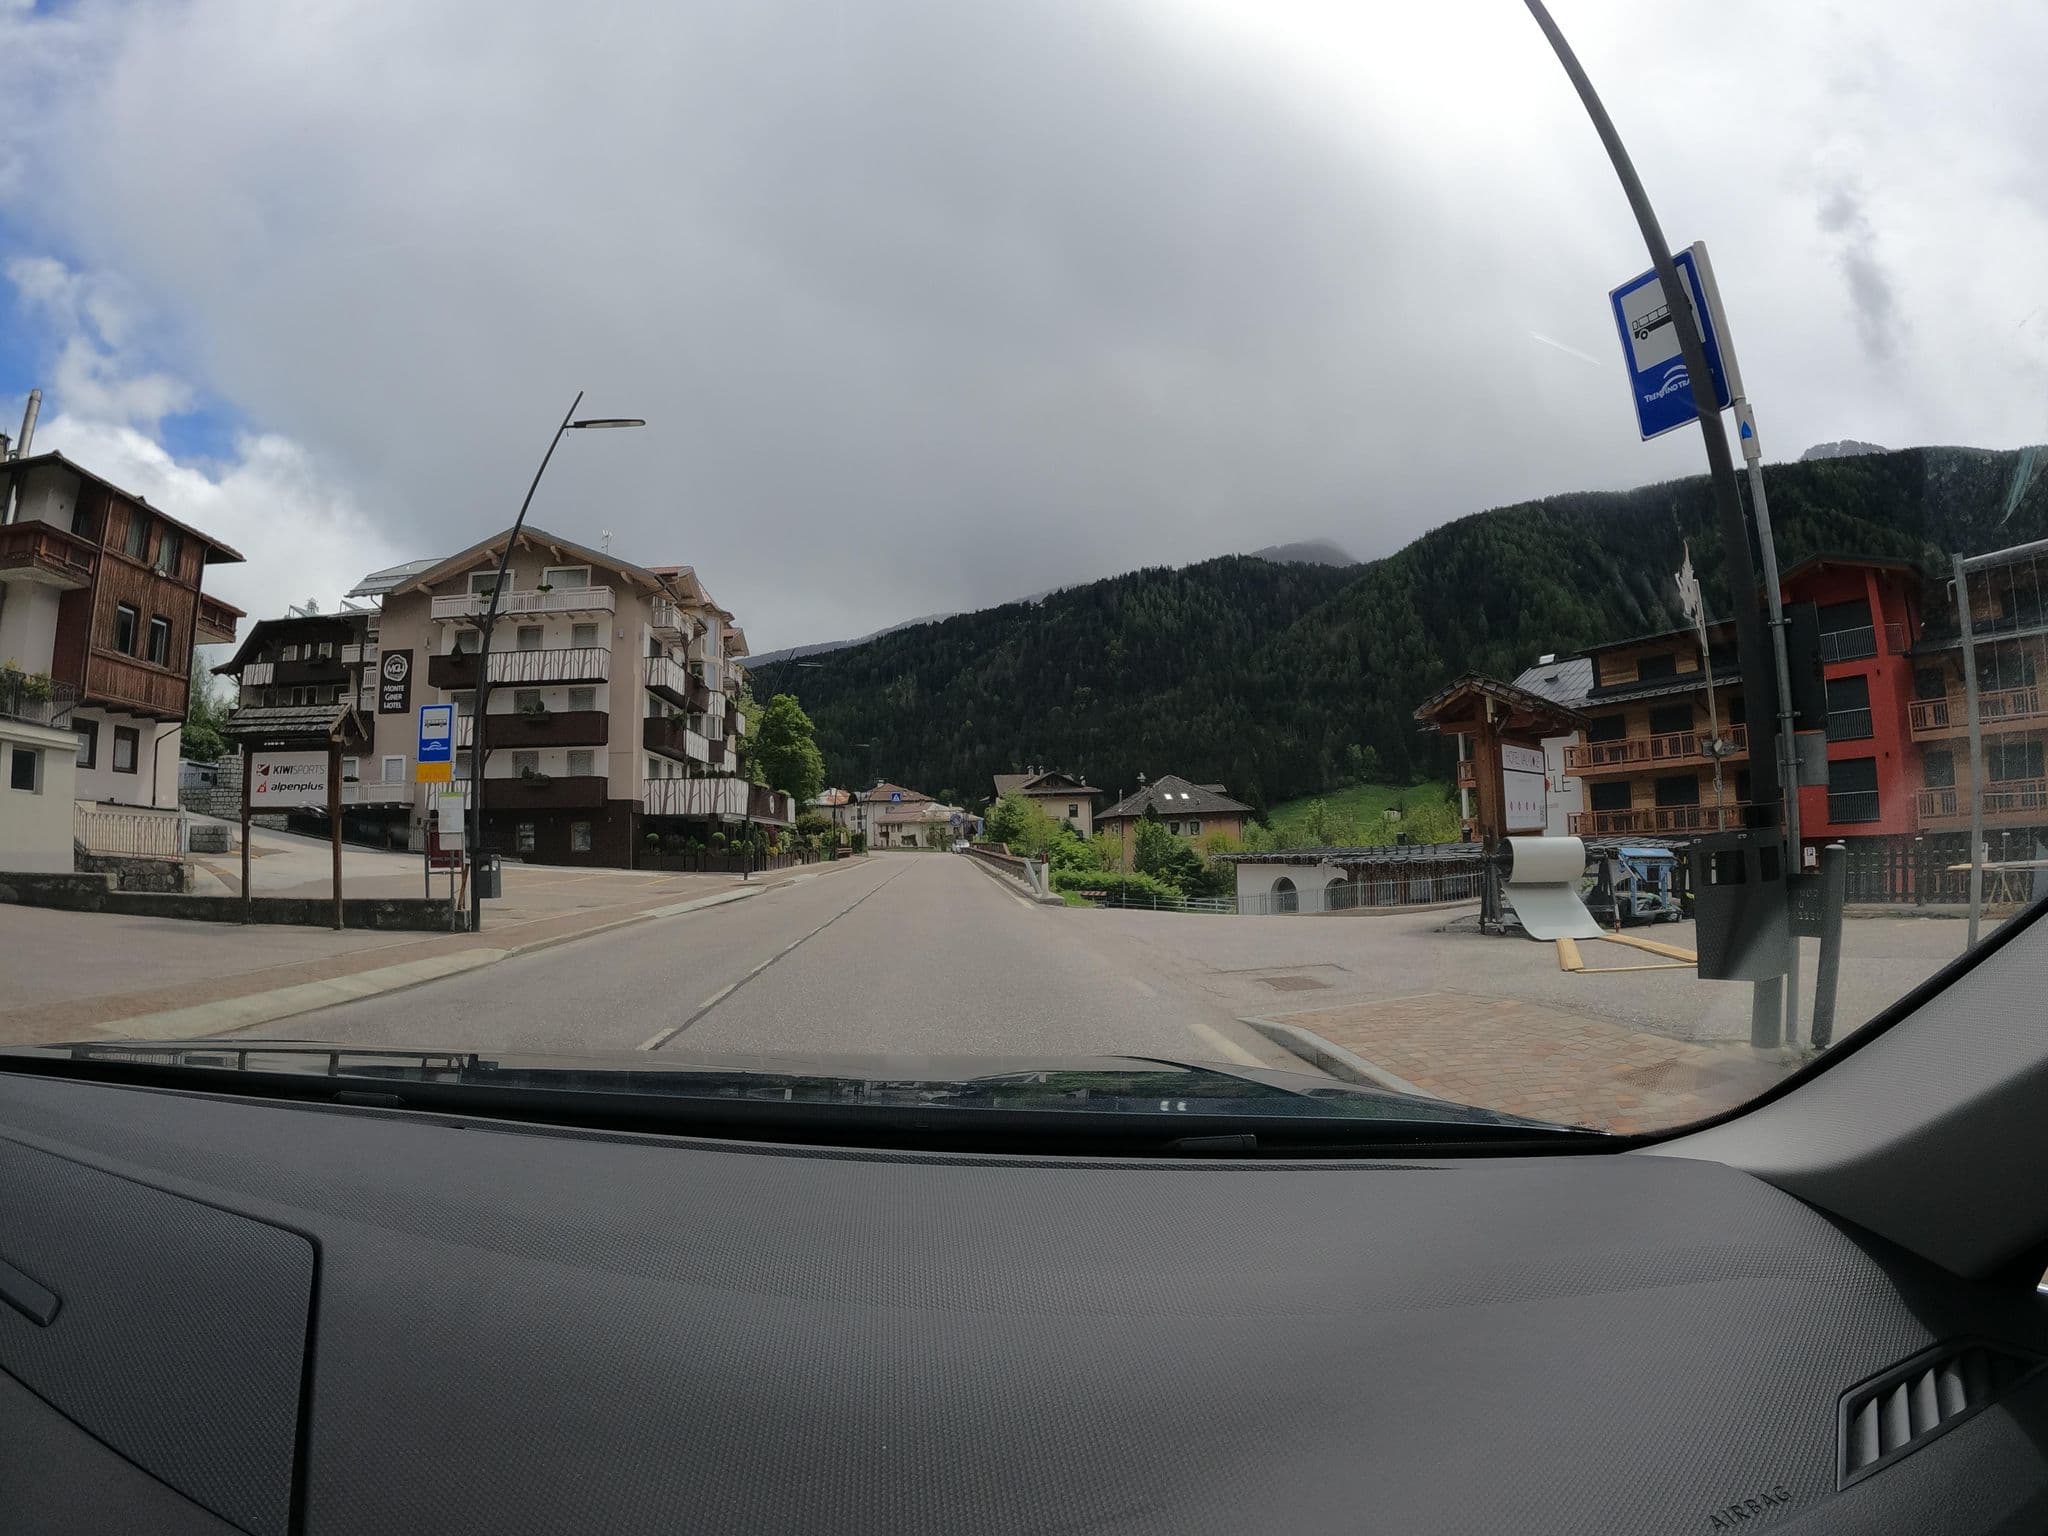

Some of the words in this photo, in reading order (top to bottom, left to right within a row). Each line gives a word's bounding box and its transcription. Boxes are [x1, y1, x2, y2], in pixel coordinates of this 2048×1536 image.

[383, 685, 405, 693] MONTE
[384, 692, 403, 701] GINER
[383, 701, 402, 710] HOTEL
[273, 764, 327, 775] KIWISPORTS
[271, 781, 324, 793] alpenplus
[1710, 1485, 1792, 1531] AIRBAG
